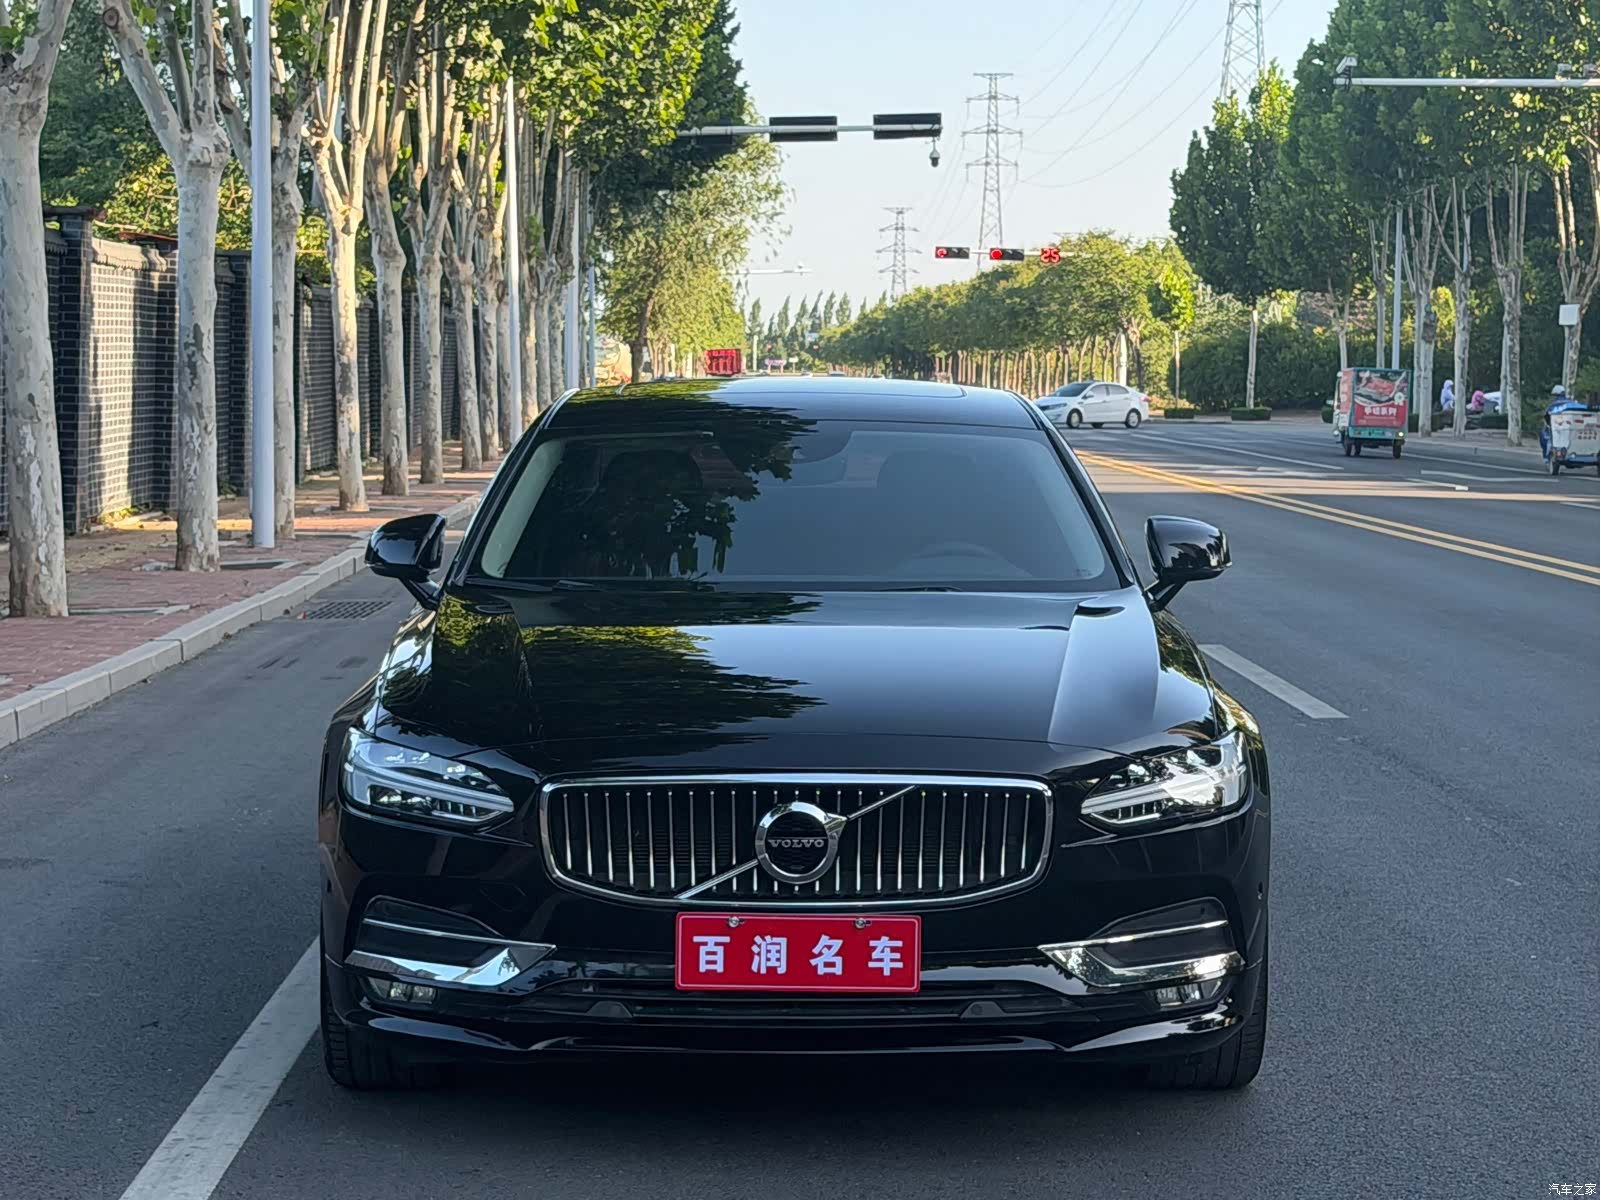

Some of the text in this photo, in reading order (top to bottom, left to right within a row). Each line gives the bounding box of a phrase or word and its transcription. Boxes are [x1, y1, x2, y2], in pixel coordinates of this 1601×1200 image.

[1041, 248, 1060, 263] 25
[767, 839, 824, 848] VOLVO
[693, 934, 904, 976] 百润名车
